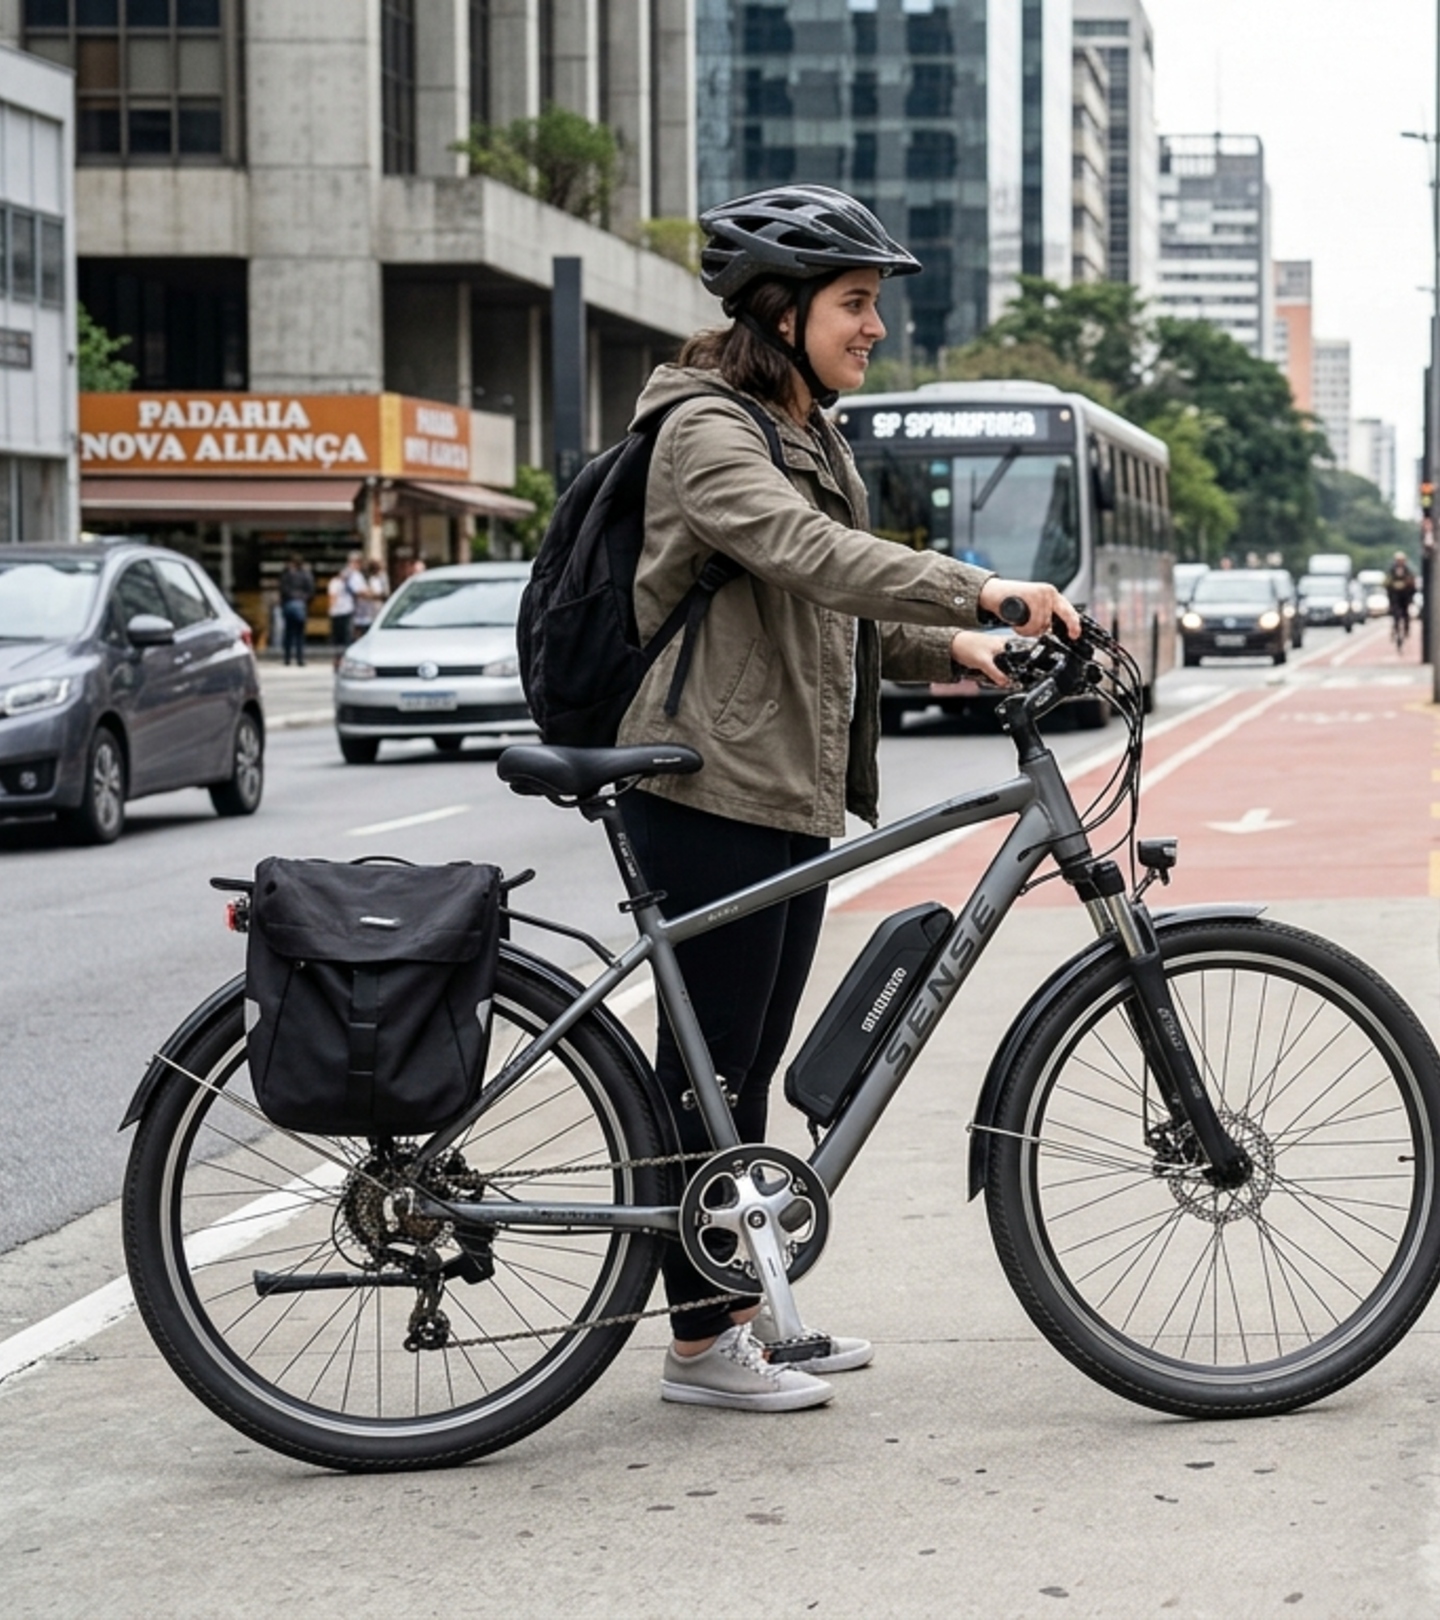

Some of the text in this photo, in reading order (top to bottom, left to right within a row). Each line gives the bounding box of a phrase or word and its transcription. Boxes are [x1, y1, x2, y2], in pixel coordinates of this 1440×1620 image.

[138, 400, 310, 429] PADARIA
[82, 433, 186, 461] NOVA
[194, 432, 368, 469] ALIANÇA
[885, 894, 996, 1077] SENSE
